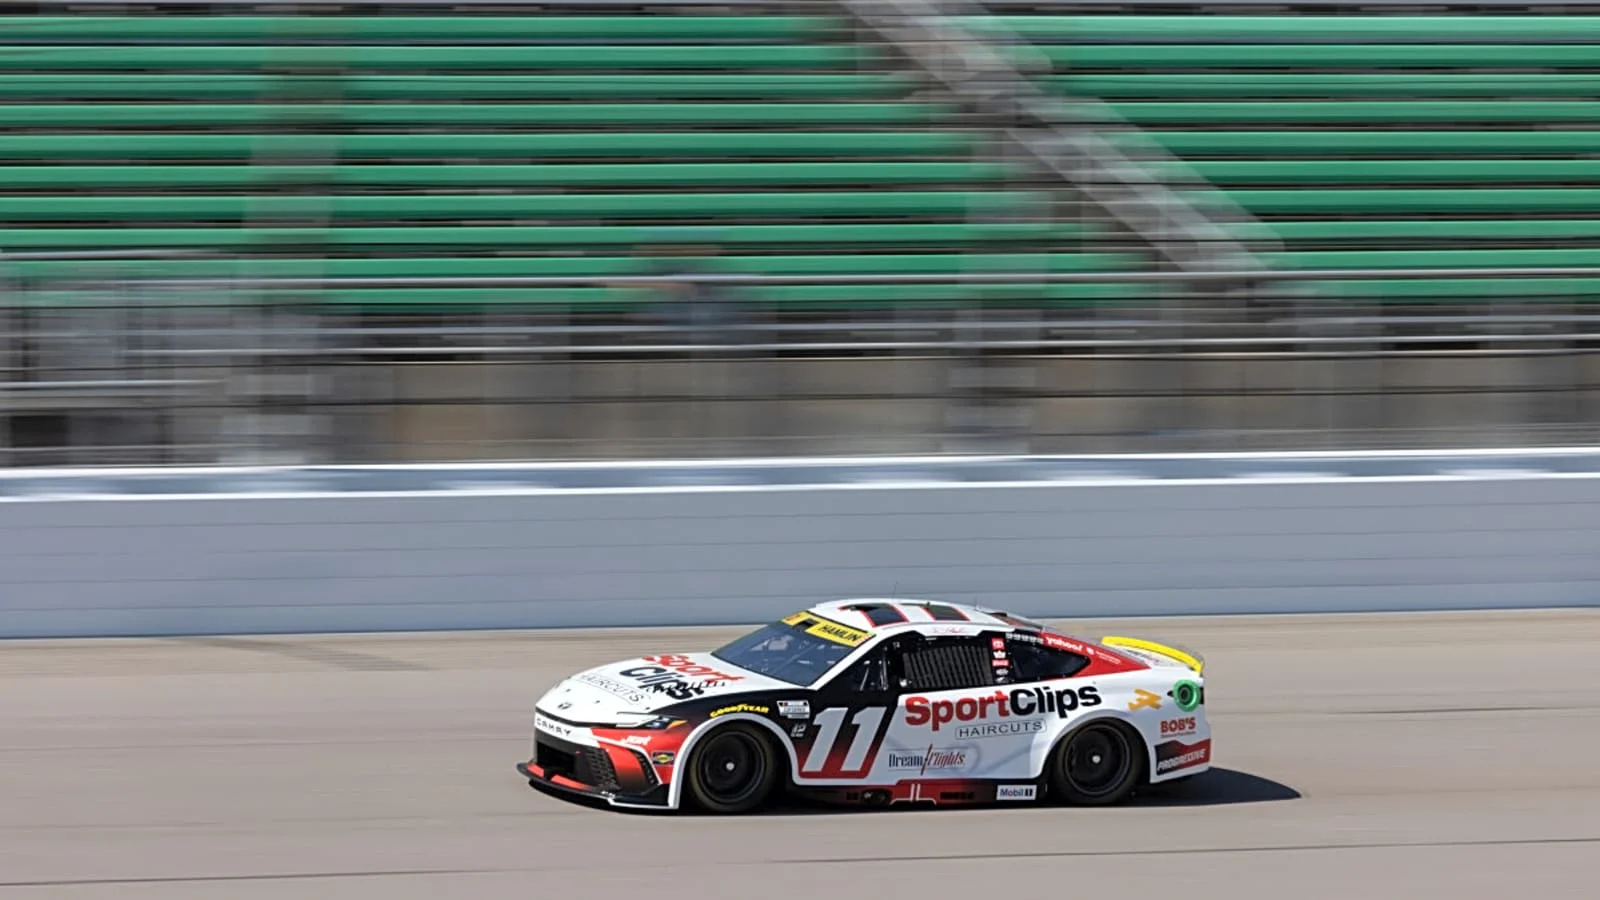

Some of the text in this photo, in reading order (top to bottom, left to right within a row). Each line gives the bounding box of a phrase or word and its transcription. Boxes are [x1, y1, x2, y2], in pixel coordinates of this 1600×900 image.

[819, 624, 863, 642] HAMLIN
[1045, 636, 1083, 652] yahoo!
[709, 703, 769, 718] GOODYEAR
[536, 718, 572, 736] CAMRY
[958, 720, 1043, 738] HAIRCUTS
[1160, 716, 1196, 733] BOB'S
[801, 706, 887, 772] 11
[1000, 788, 1024, 797] Mobil
